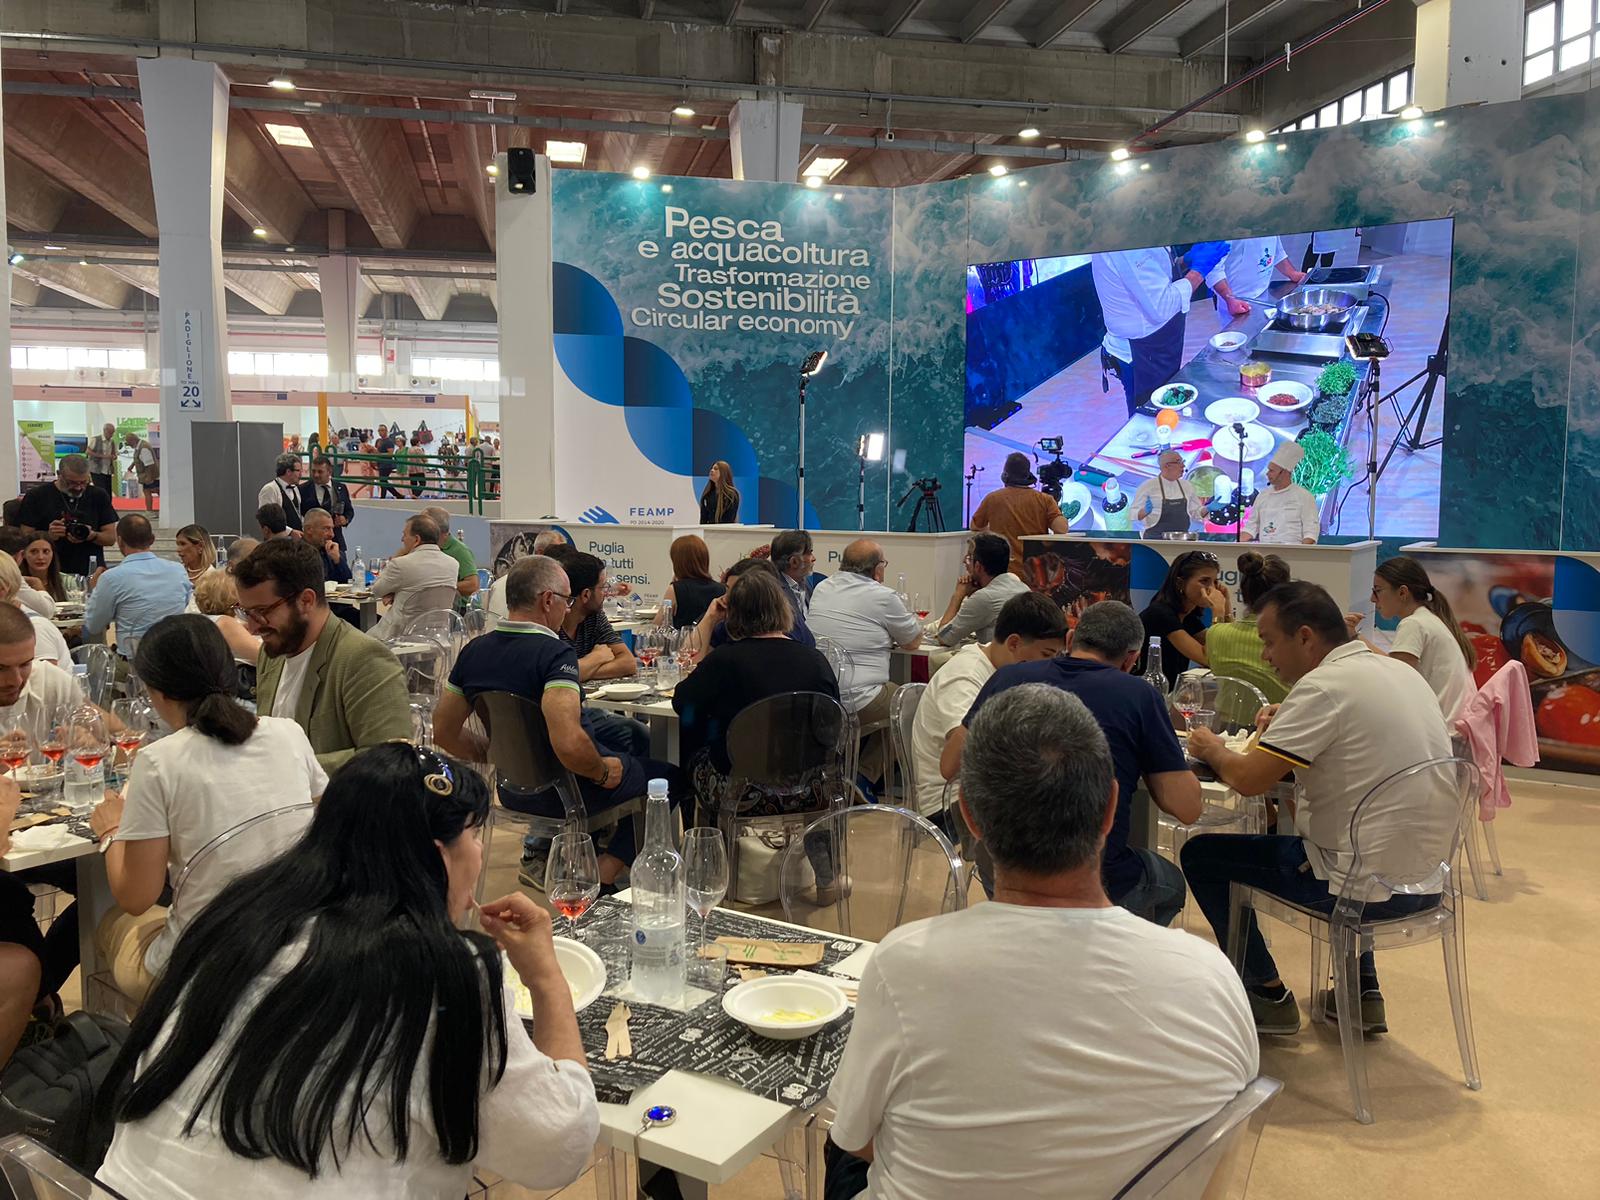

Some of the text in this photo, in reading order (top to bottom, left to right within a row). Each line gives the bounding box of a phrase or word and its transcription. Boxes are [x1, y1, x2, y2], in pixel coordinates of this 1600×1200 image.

[664, 205, 784, 242] Pesca
[638, 240, 870, 266] e acquacoltura
[674, 264, 871, 289] Trasformazione
[657, 283, 860, 315] Sostenibilità
[631, 308, 854, 341] Circular economy
[185, 312, 193, 379] PADIGLIONE
[183, 386, 200, 397] 20
[630, 508, 674, 516] FEAMP
[589, 541, 625, 555] Puglia
[612, 558, 634, 569] tutti
[616, 574, 650, 585] sensi.
